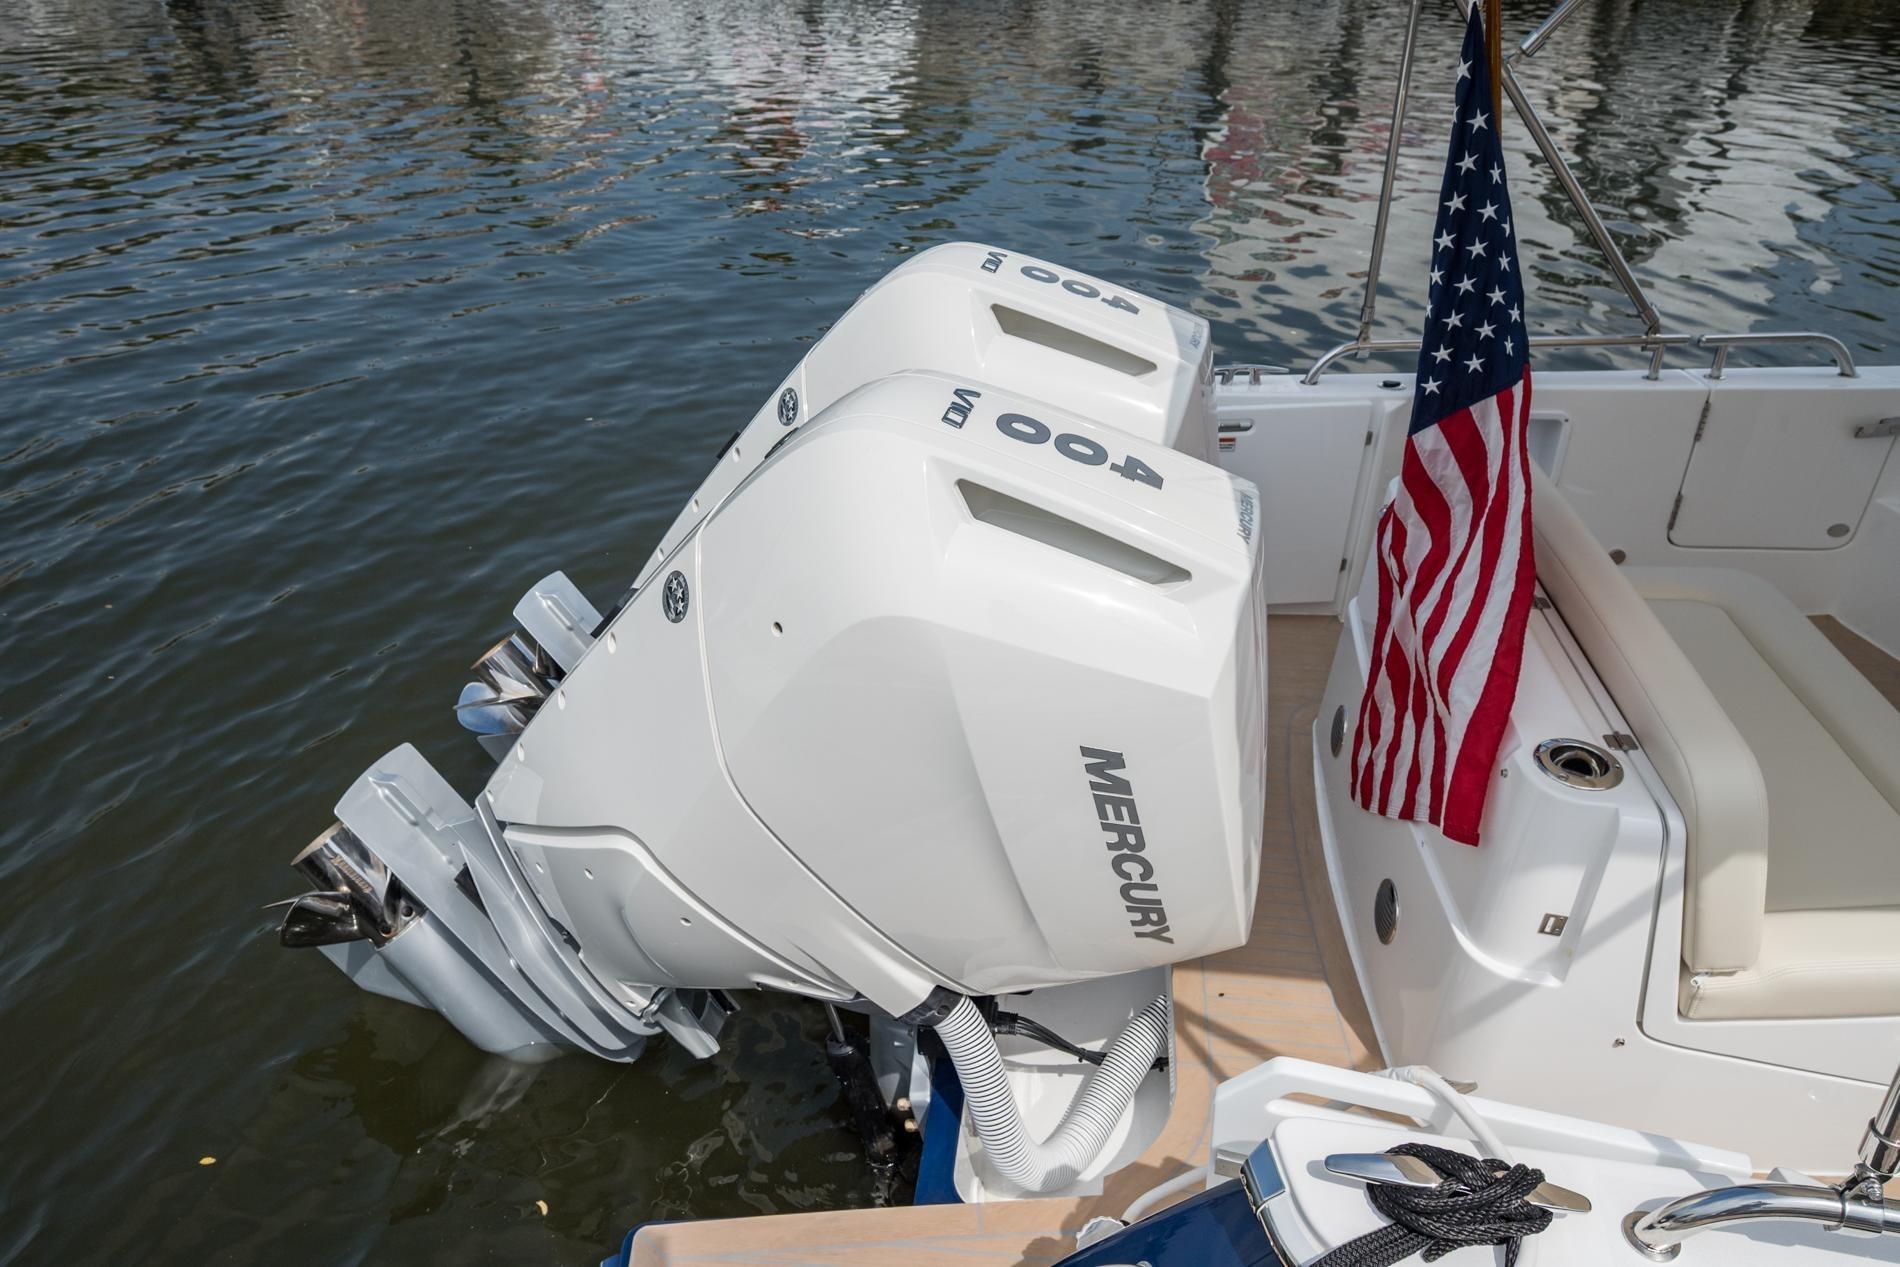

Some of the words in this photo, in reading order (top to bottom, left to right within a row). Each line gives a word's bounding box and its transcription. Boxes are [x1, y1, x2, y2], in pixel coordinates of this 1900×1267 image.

[1020, 265, 1140, 315] 400
[996, 413, 1164, 490] 400
[1236, 492, 1254, 545] MERCURY
[1079, 745, 1174, 944] MERCURY
